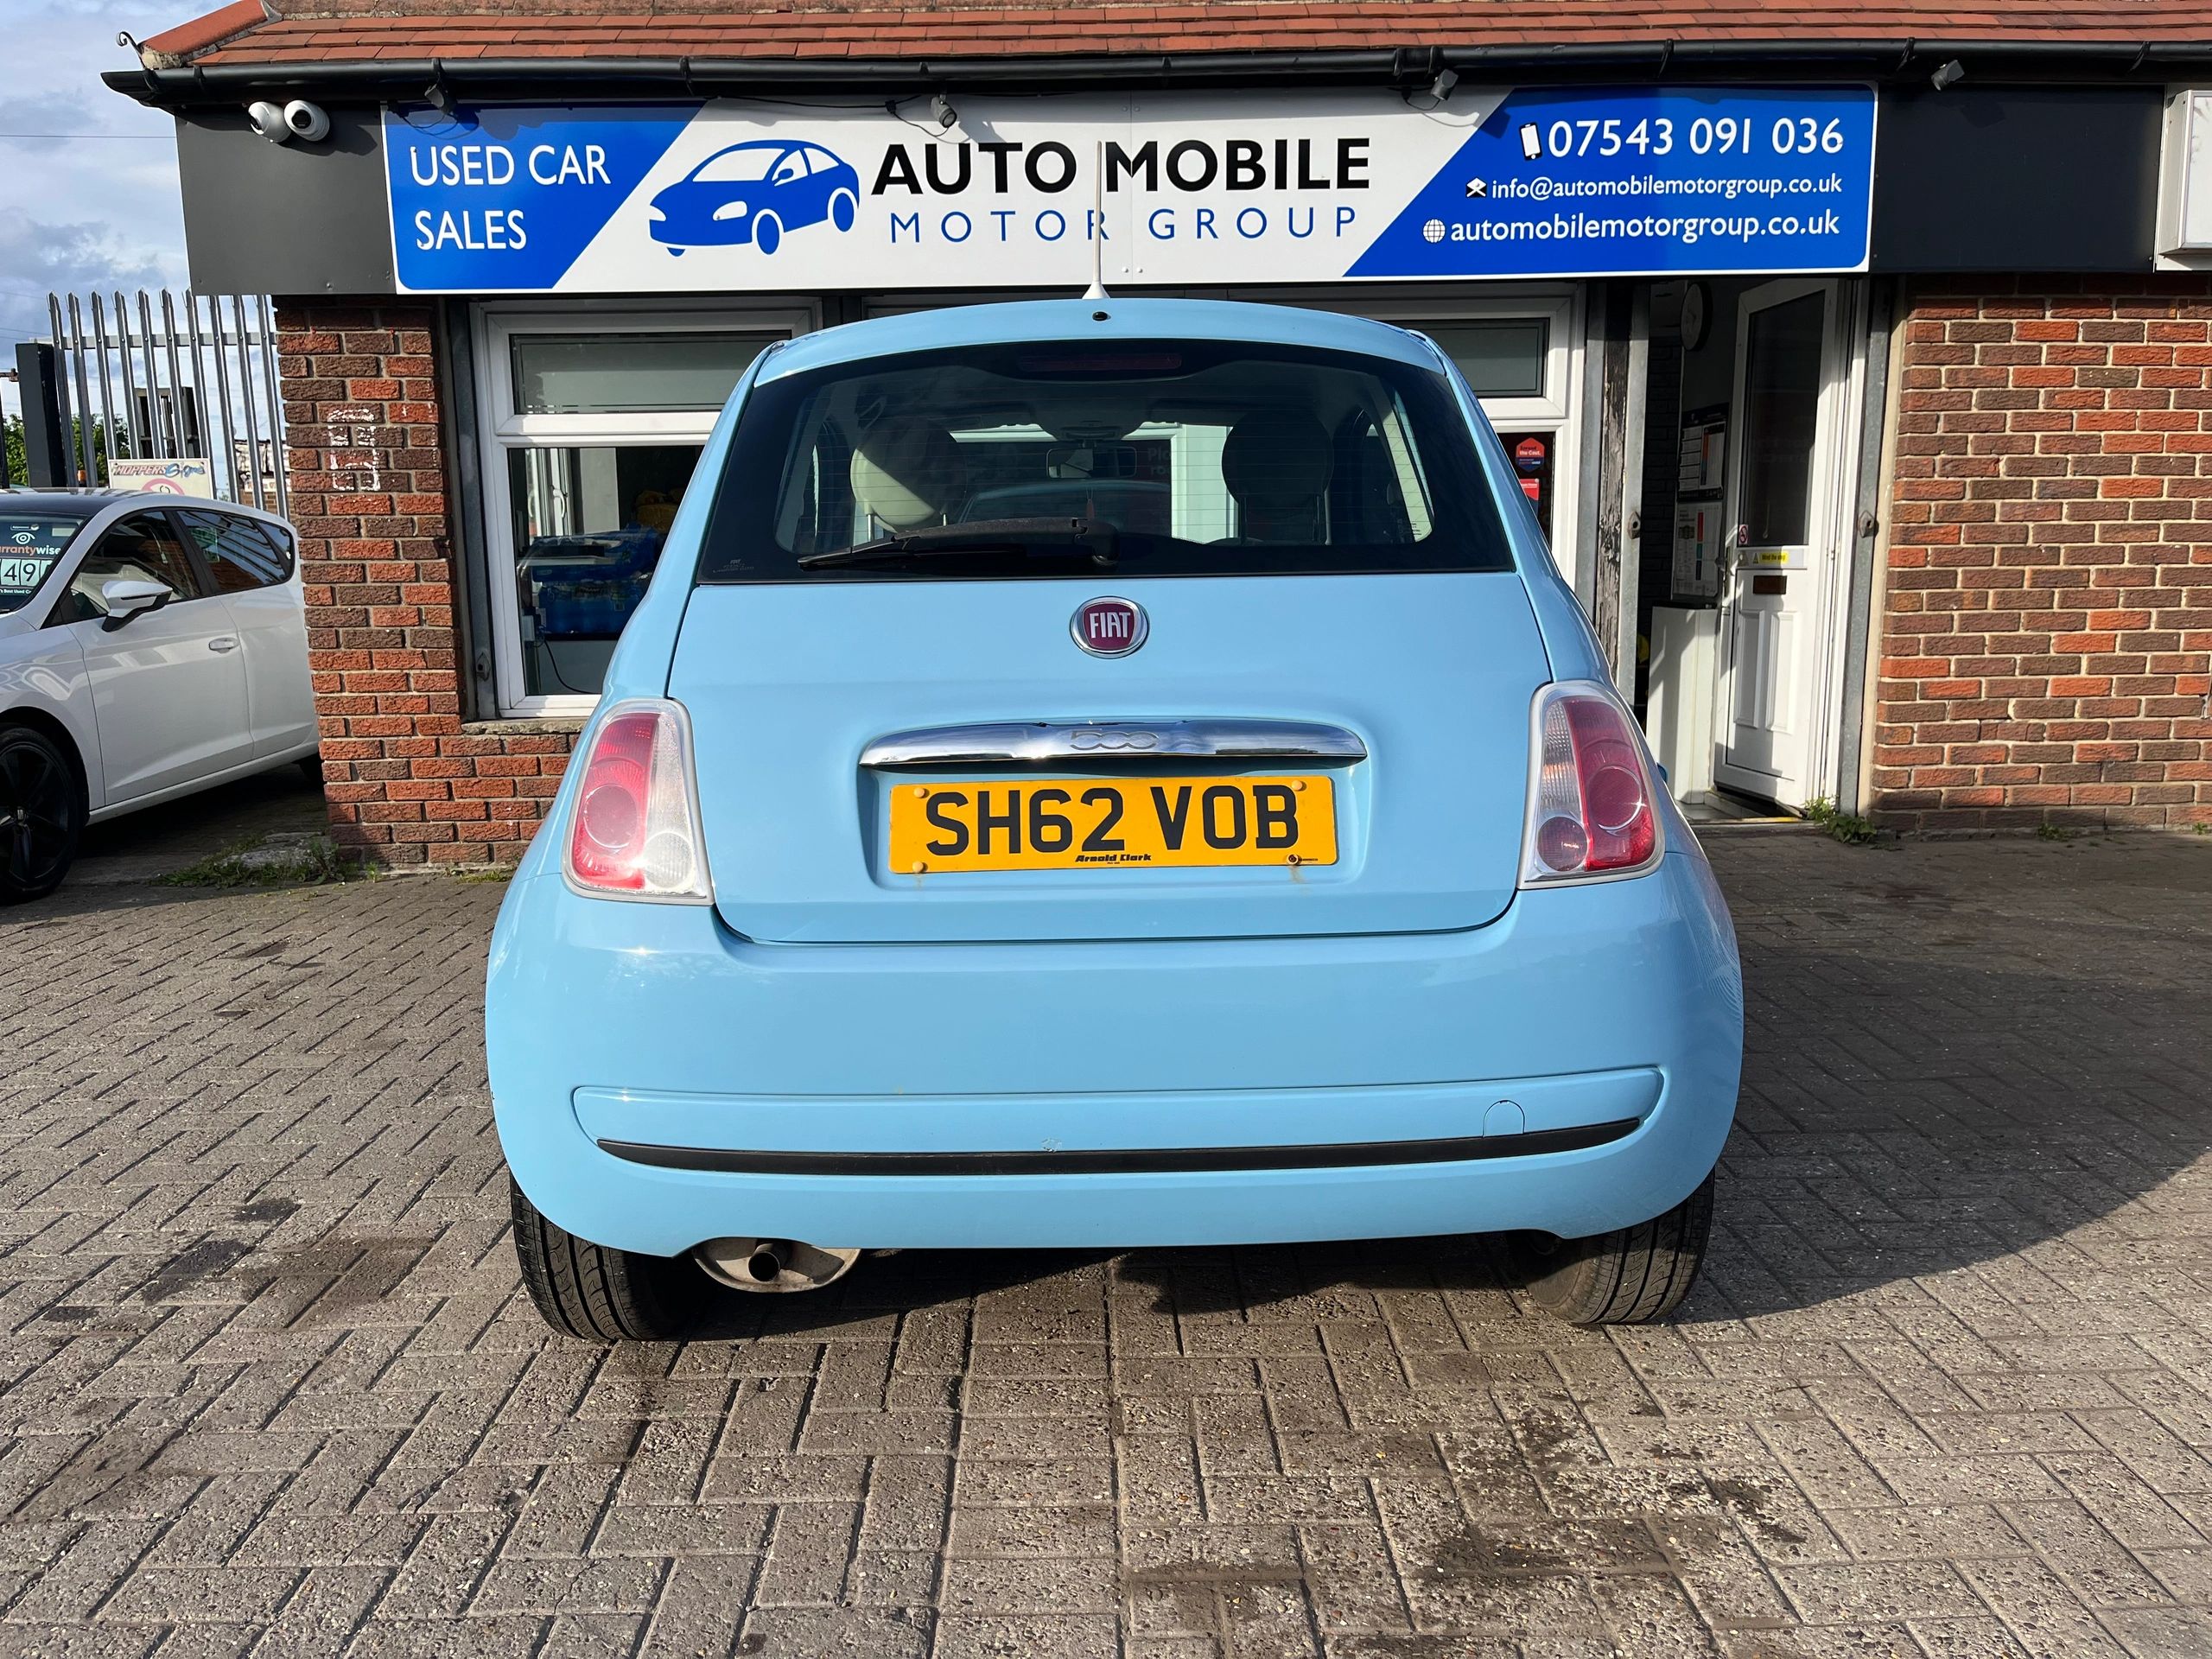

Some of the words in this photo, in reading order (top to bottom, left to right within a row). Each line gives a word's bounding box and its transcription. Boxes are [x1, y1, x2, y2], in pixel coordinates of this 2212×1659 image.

[1548, 118, 1674, 158] 07543
[1689, 118, 1751, 156] 091
[1771, 118, 1845, 156] 036
[410, 144, 515, 186] USED
[528, 144, 611, 185] CAR
[871, 141, 1077, 195] AUTO
[1106, 137, 1370, 193] MOBILE
[1491, 173, 1842, 200] info@automobilemotorgroup.co.uk
[415, 209, 527, 251] SALES
[891, 209, 1109, 244] MOTOR
[1148, 206, 1356, 240] GROUP
[1451, 209, 1840, 243] automobilemotorgroup.co.uk
[1089, 611, 1131, 639] FIAT
[1070, 728, 1160, 751] 500
[925, 786, 1126, 856] SH62
[1150, 785, 1300, 851] VOB
[1075, 854, 1117, 862] Arnold
